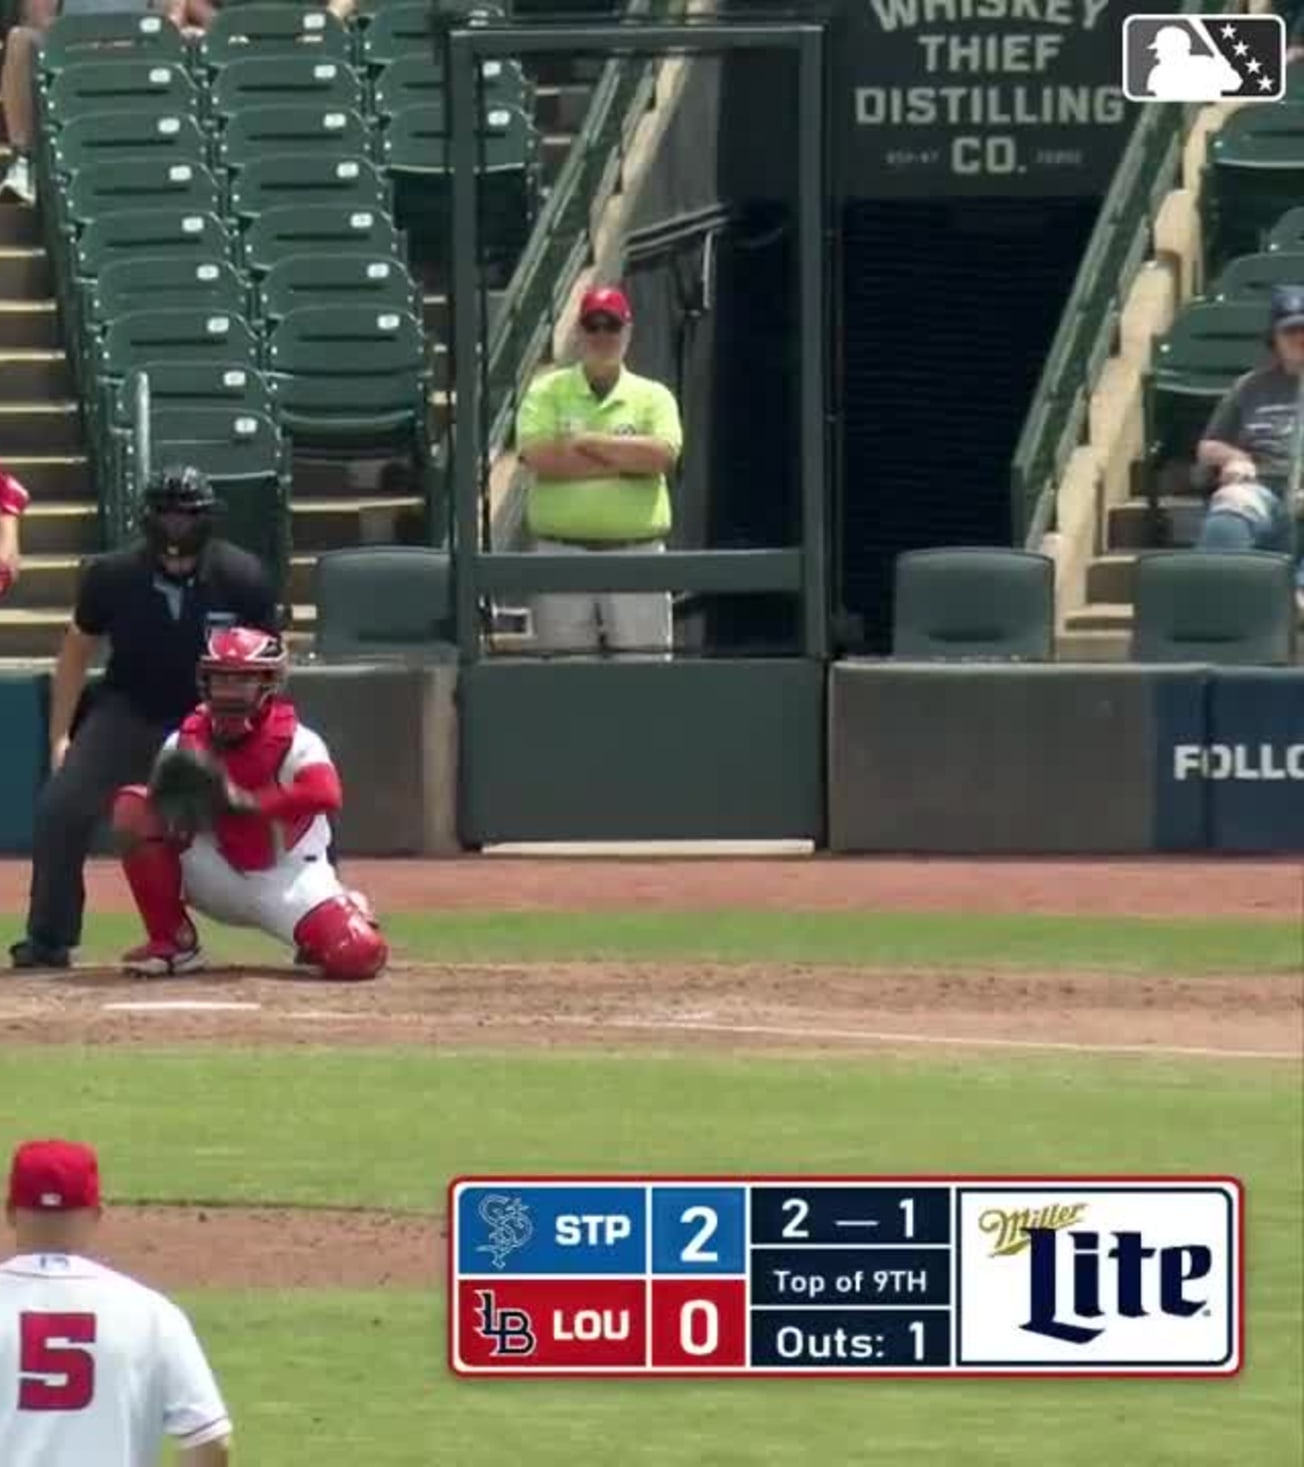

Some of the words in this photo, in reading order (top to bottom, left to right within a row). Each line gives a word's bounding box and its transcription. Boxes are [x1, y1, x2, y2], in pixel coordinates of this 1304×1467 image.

[918, 35, 1063, 72] THIEF
[854, 86, 1125, 124] DISTILLING
[952, 137, 1027, 173] CO.
[18, 1312, 97, 1411] 5
